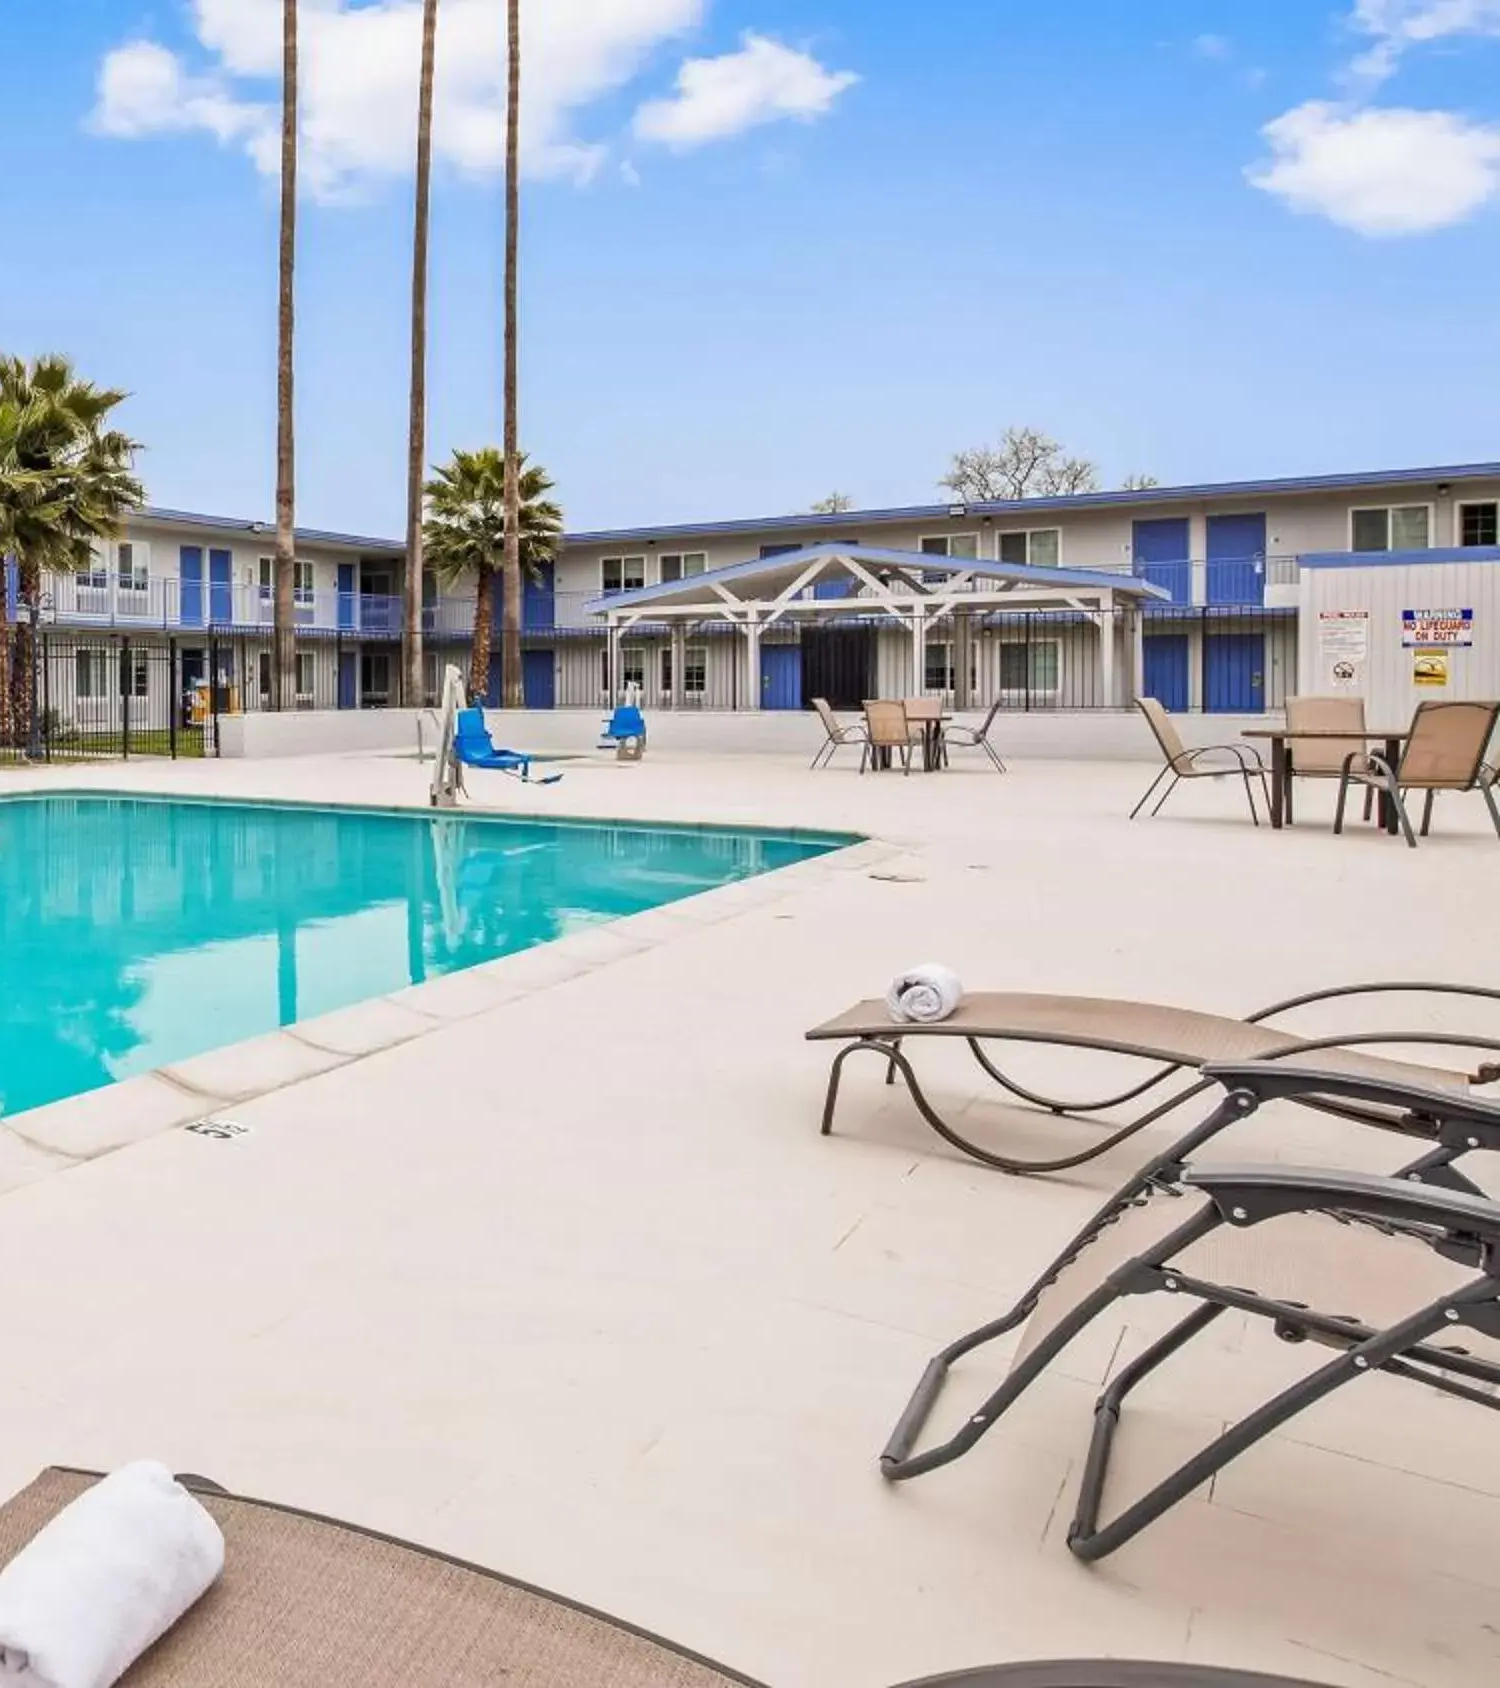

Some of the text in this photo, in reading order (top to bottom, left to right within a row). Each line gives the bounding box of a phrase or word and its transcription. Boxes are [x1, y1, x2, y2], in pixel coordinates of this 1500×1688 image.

[1403, 620, 1471, 630] NO LIFEGUARD
[1415, 631, 1457, 641] ON DUTY
